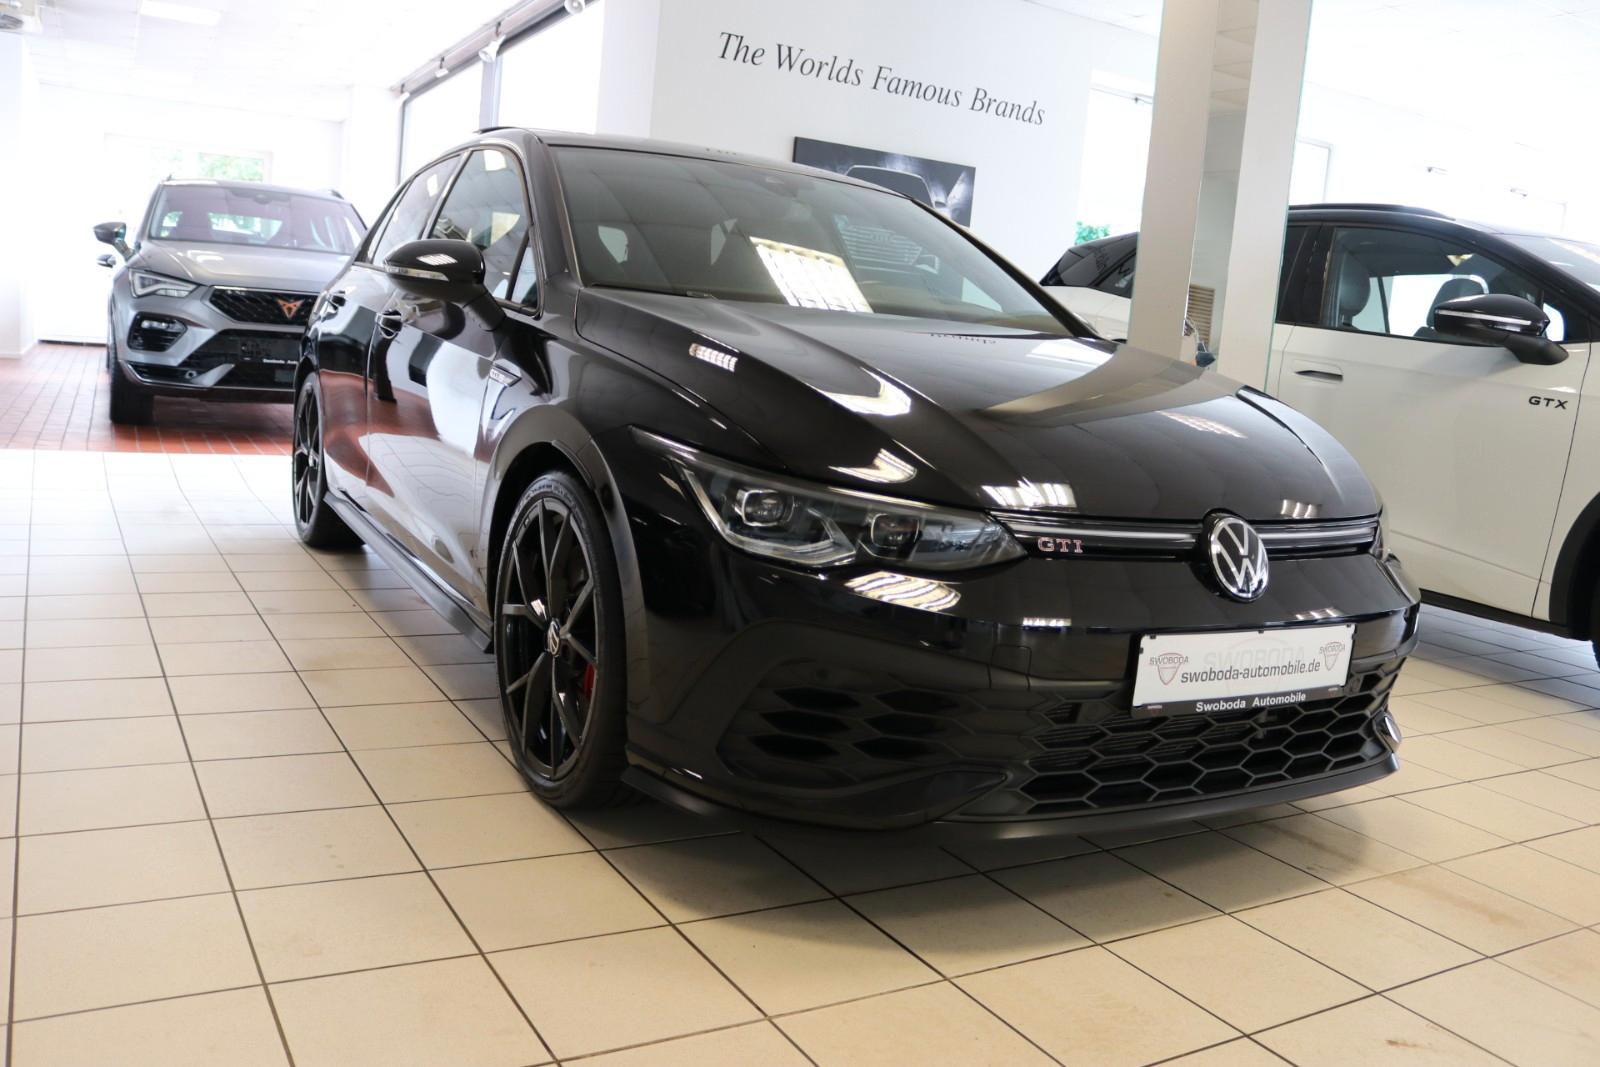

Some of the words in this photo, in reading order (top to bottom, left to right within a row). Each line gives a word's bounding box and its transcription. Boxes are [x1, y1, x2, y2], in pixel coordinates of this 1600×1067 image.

[718, 31, 765, 66] The
[775, 43, 864, 87] Worlds
[872, 65, 962, 108] Famous
[969, 87, 1046, 126] Brands
[1528, 395, 1568, 410] GTX
[1037, 536, 1084, 554] GTI
[1149, 655, 1189, 665] SWOBODA
[1180, 658, 1321, 684] swoboda-automobile.de
[1195, 699, 1246, 713] Swoboda
[1252, 692, 1306, 708] Automobile
